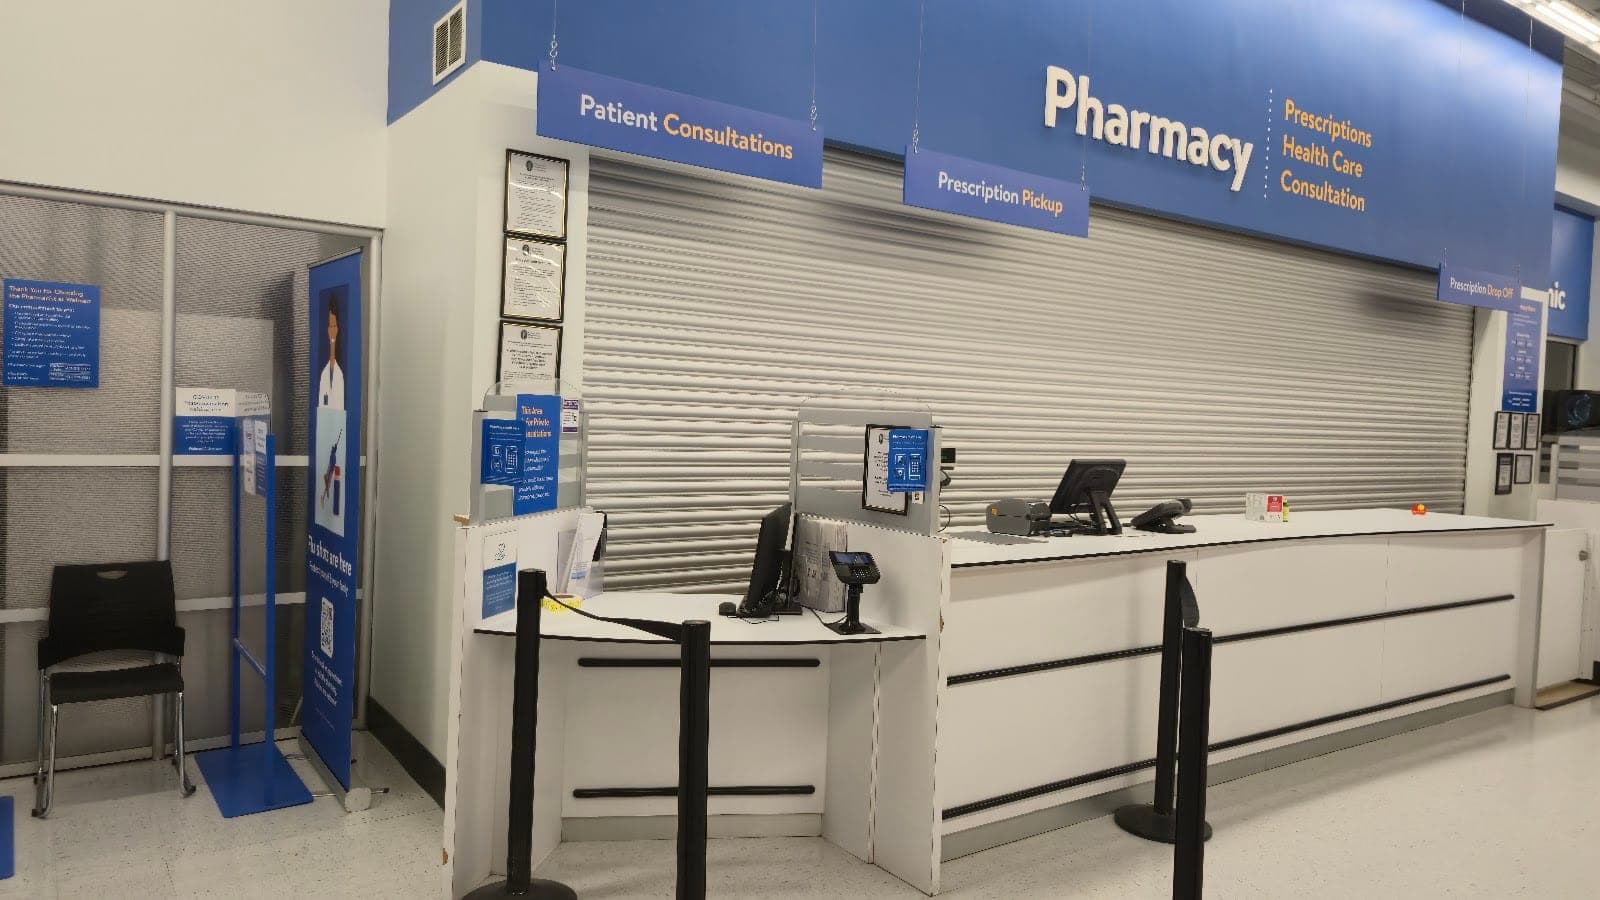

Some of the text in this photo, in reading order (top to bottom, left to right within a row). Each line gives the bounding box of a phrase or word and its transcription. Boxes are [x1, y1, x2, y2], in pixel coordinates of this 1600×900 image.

[579, 93, 793, 160] Patient Consultations
[1044, 65, 1254, 192] Pharmacy
[1284, 98, 1373, 148] Prescriptions
[1282, 133, 1363, 178] Health Care
[938, 170, 1063, 218] Prescription Pickup
[1280, 169, 1366, 213] Consultation
[1450, 277, 1487, 296] Prescription
[340, 551, 352, 577] here
